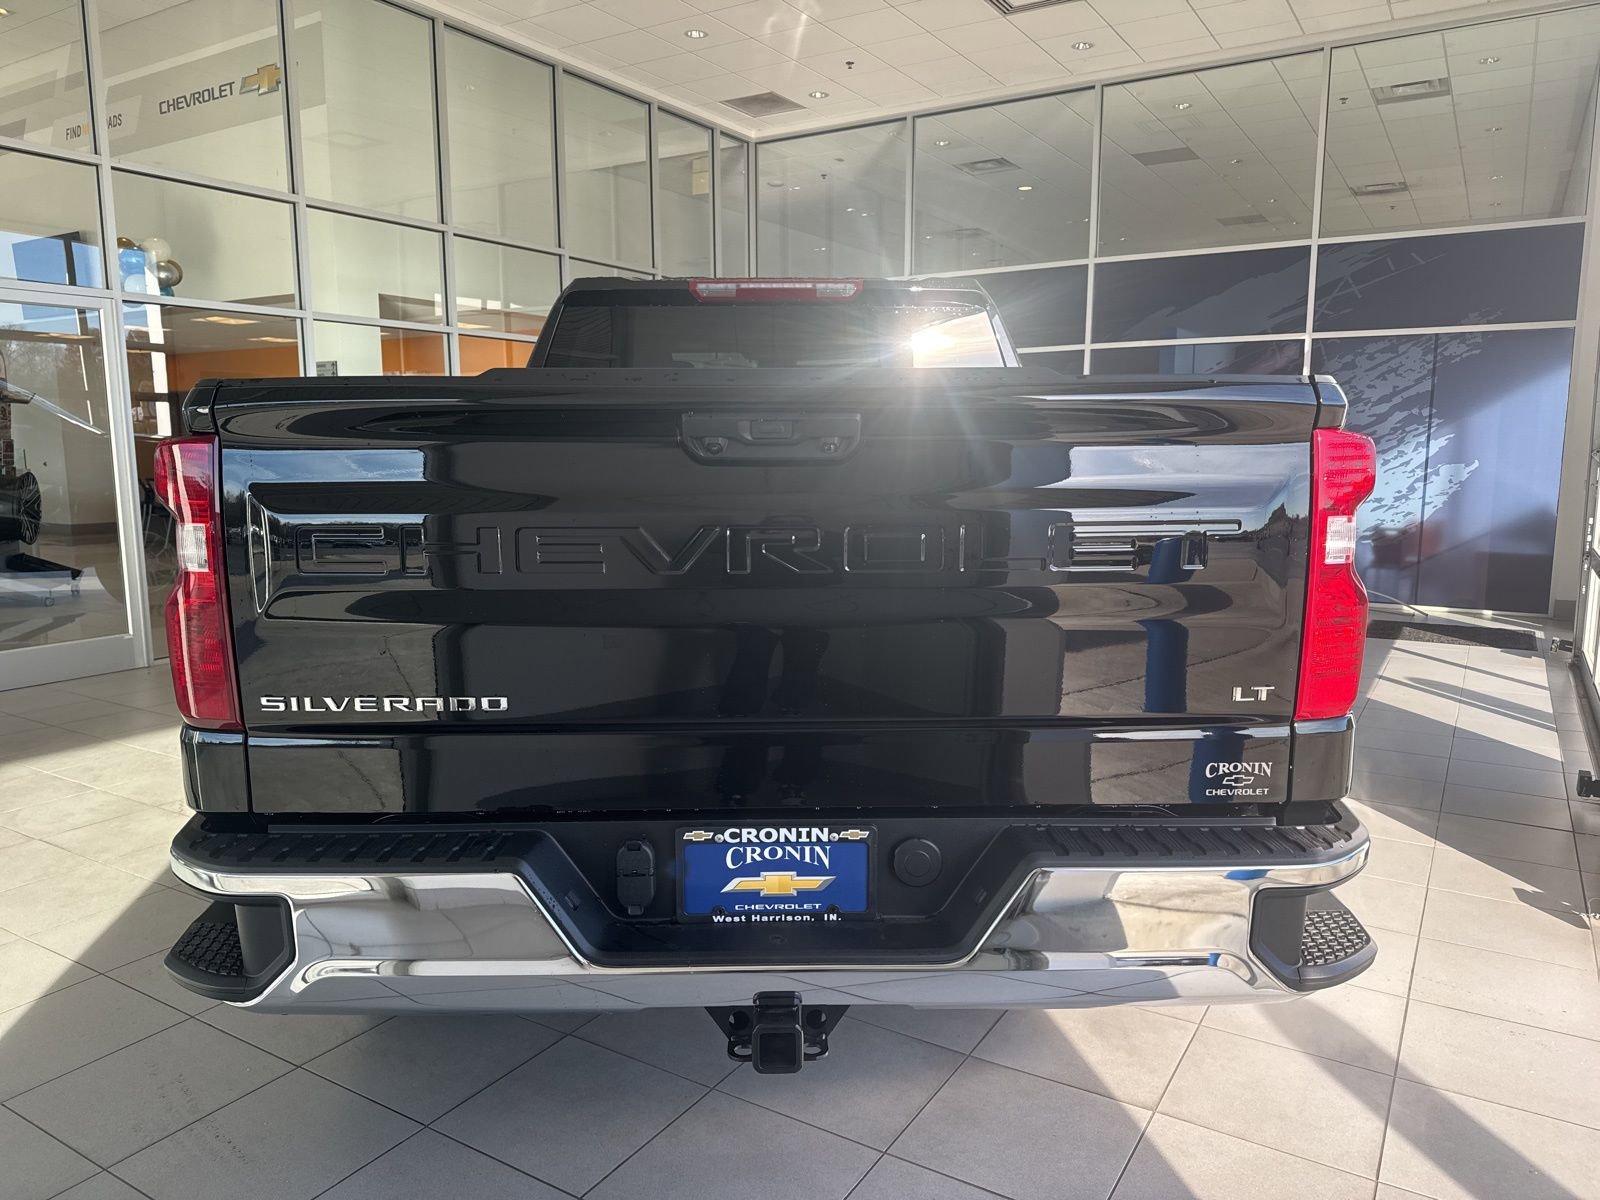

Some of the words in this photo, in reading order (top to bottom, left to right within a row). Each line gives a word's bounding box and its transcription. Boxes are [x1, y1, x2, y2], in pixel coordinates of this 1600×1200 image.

[159, 81, 236, 115] CHEVROLET
[65, 124, 82, 141] FIND
[106, 113, 122, 129] ADS
[296, 518, 1243, 577] CHEVROLET
[1231, 686, 1275, 702] LT
[259, 696, 509, 712] SILVERADO
[1205, 762, 1272, 778] CRONIN
[1206, 788, 1270, 796] CHEVROLET
[723, 827, 829, 843] CRONIN
[725, 845, 831, 870] CRONIN
[712, 914, 746, 923] West
[751, 914, 815, 922] Harrison,
[824, 913, 842, 921] IN.
